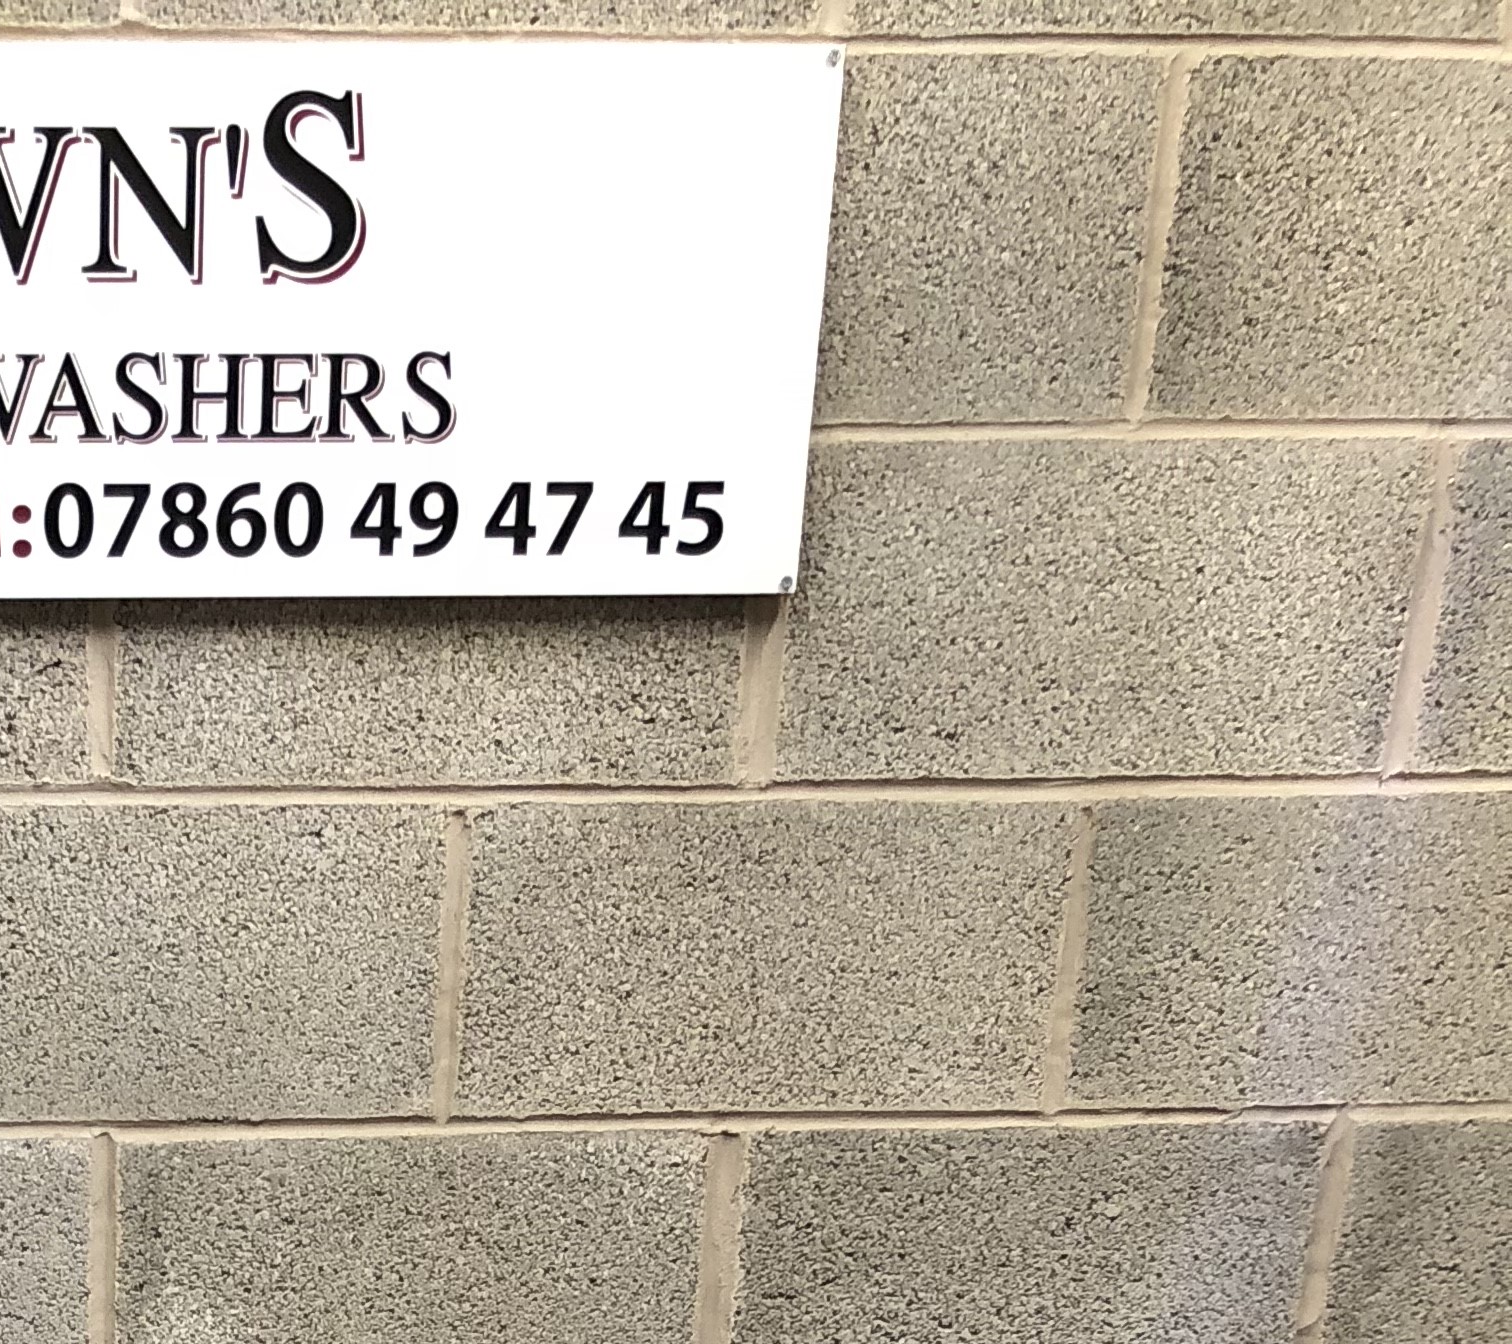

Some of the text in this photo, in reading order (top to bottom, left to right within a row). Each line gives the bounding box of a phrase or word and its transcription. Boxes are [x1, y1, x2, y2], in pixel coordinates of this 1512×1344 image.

[349, 480, 460, 558] 49
[484, 480, 594, 557] 47
[617, 479, 725, 557] 45
